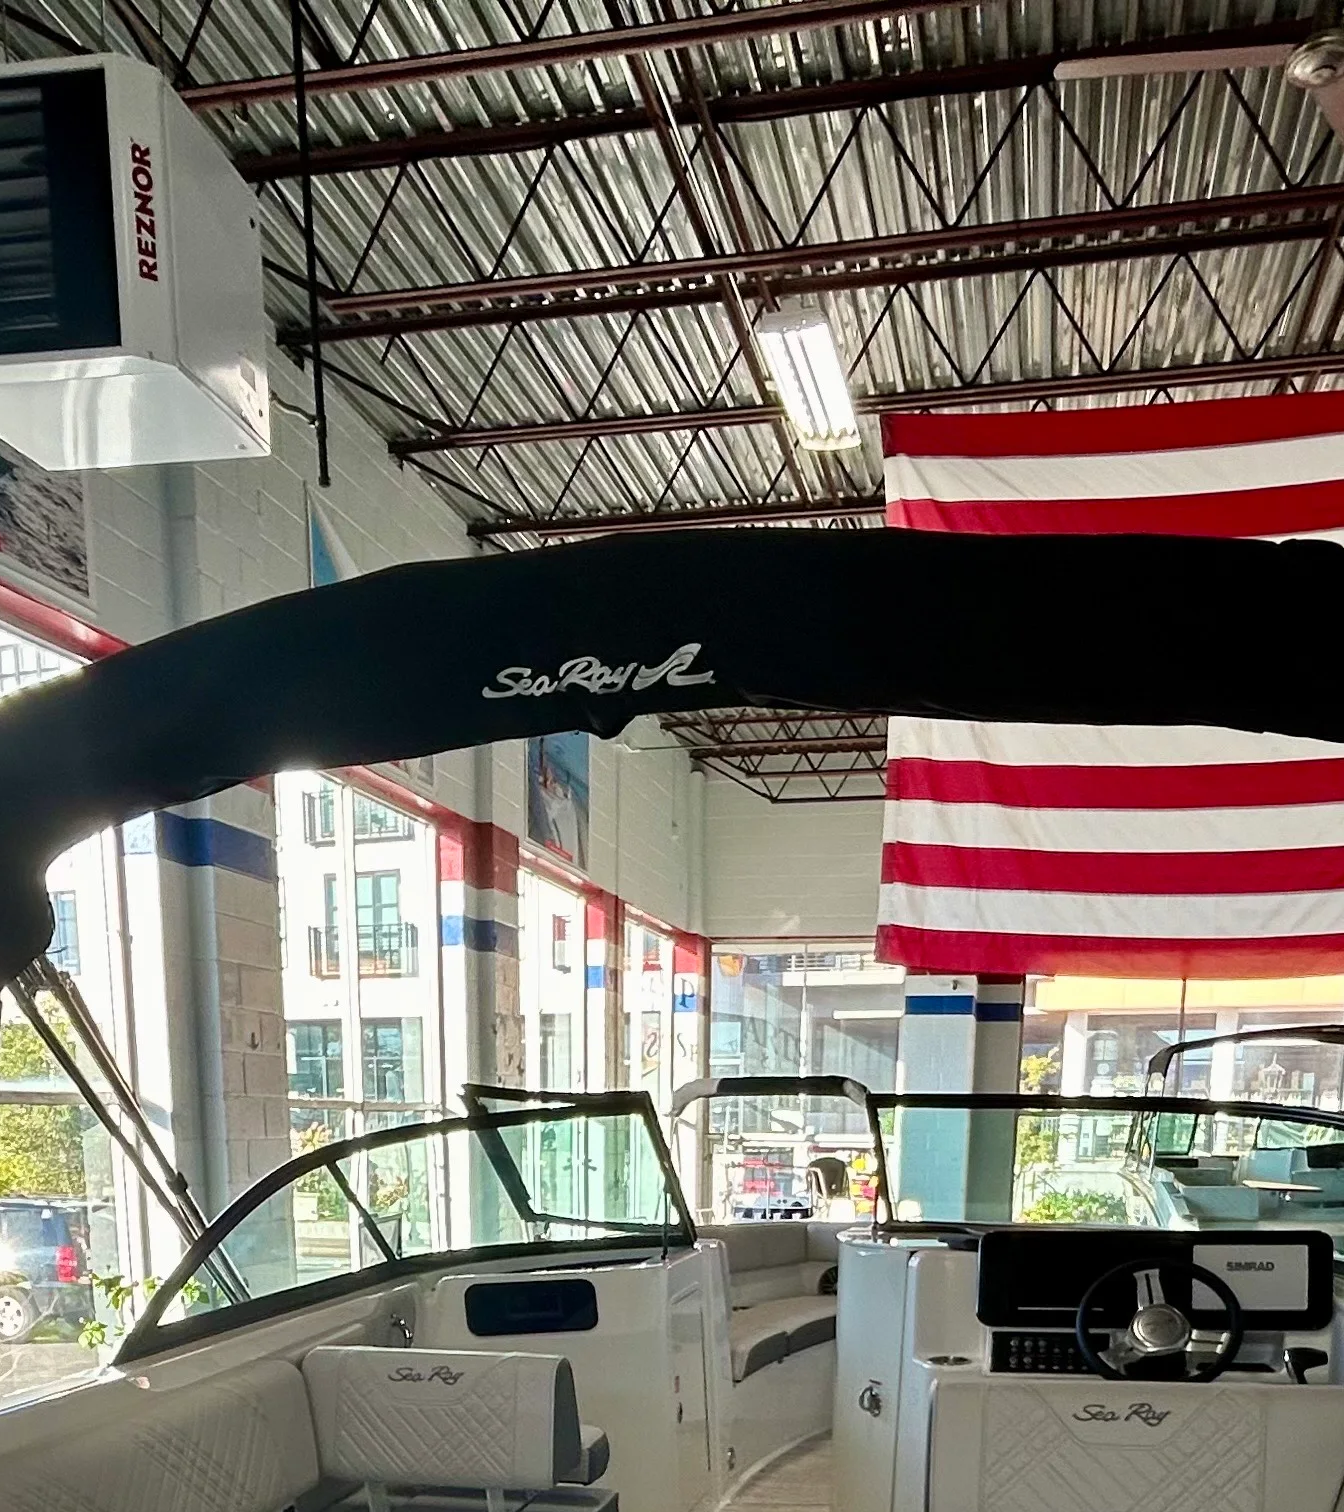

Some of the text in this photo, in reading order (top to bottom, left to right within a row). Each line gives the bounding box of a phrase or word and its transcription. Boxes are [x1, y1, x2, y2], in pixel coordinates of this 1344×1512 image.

[131, 142, 158, 282] REZNOR
[482, 656, 638, 699] Sea Ray
[1226, 1261, 1275, 1271] SIMRAD
[387, 1365, 464, 1385] Sea Ray
[1072, 1402, 1171, 1427] Sea Ray
